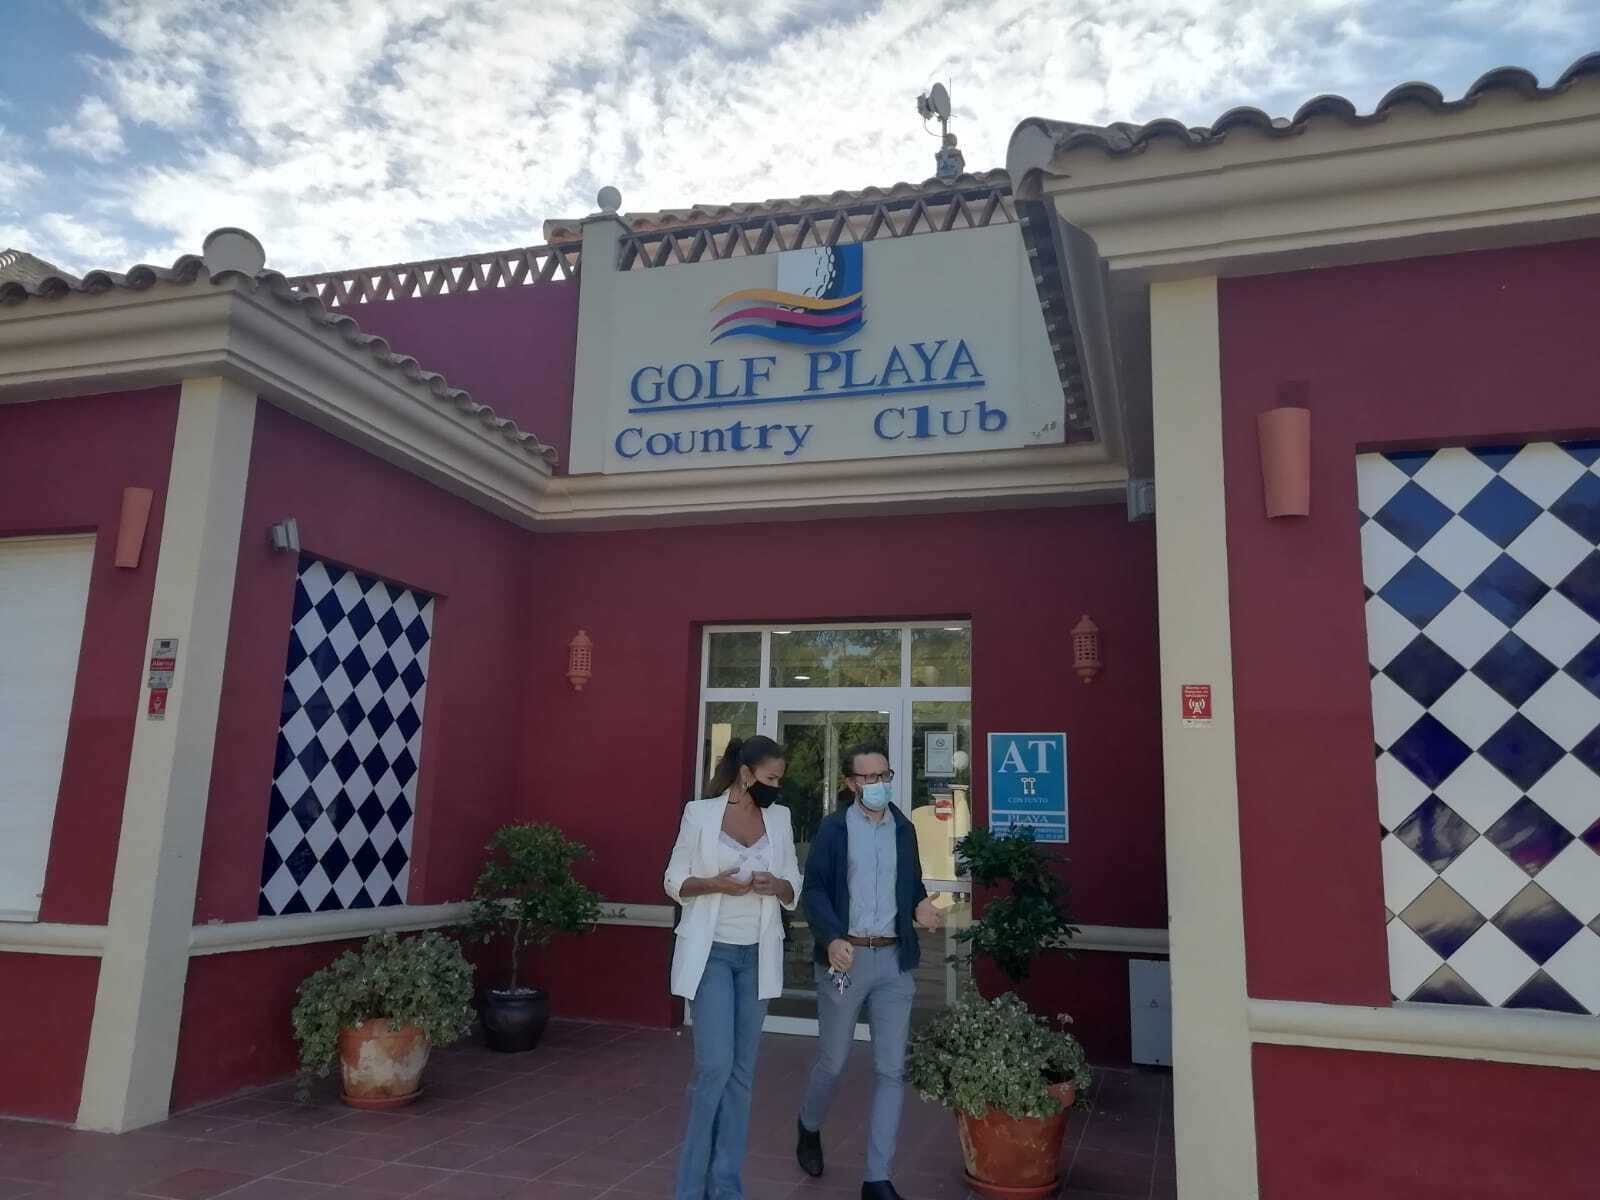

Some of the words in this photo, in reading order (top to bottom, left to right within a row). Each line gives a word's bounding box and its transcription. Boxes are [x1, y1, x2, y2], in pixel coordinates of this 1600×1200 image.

[630, 355, 777, 404] GOLF
[803, 338, 983, 391] PLAYA
[997, 740, 1057, 774] AT
[1007, 814, 1049, 823] PLAYA
